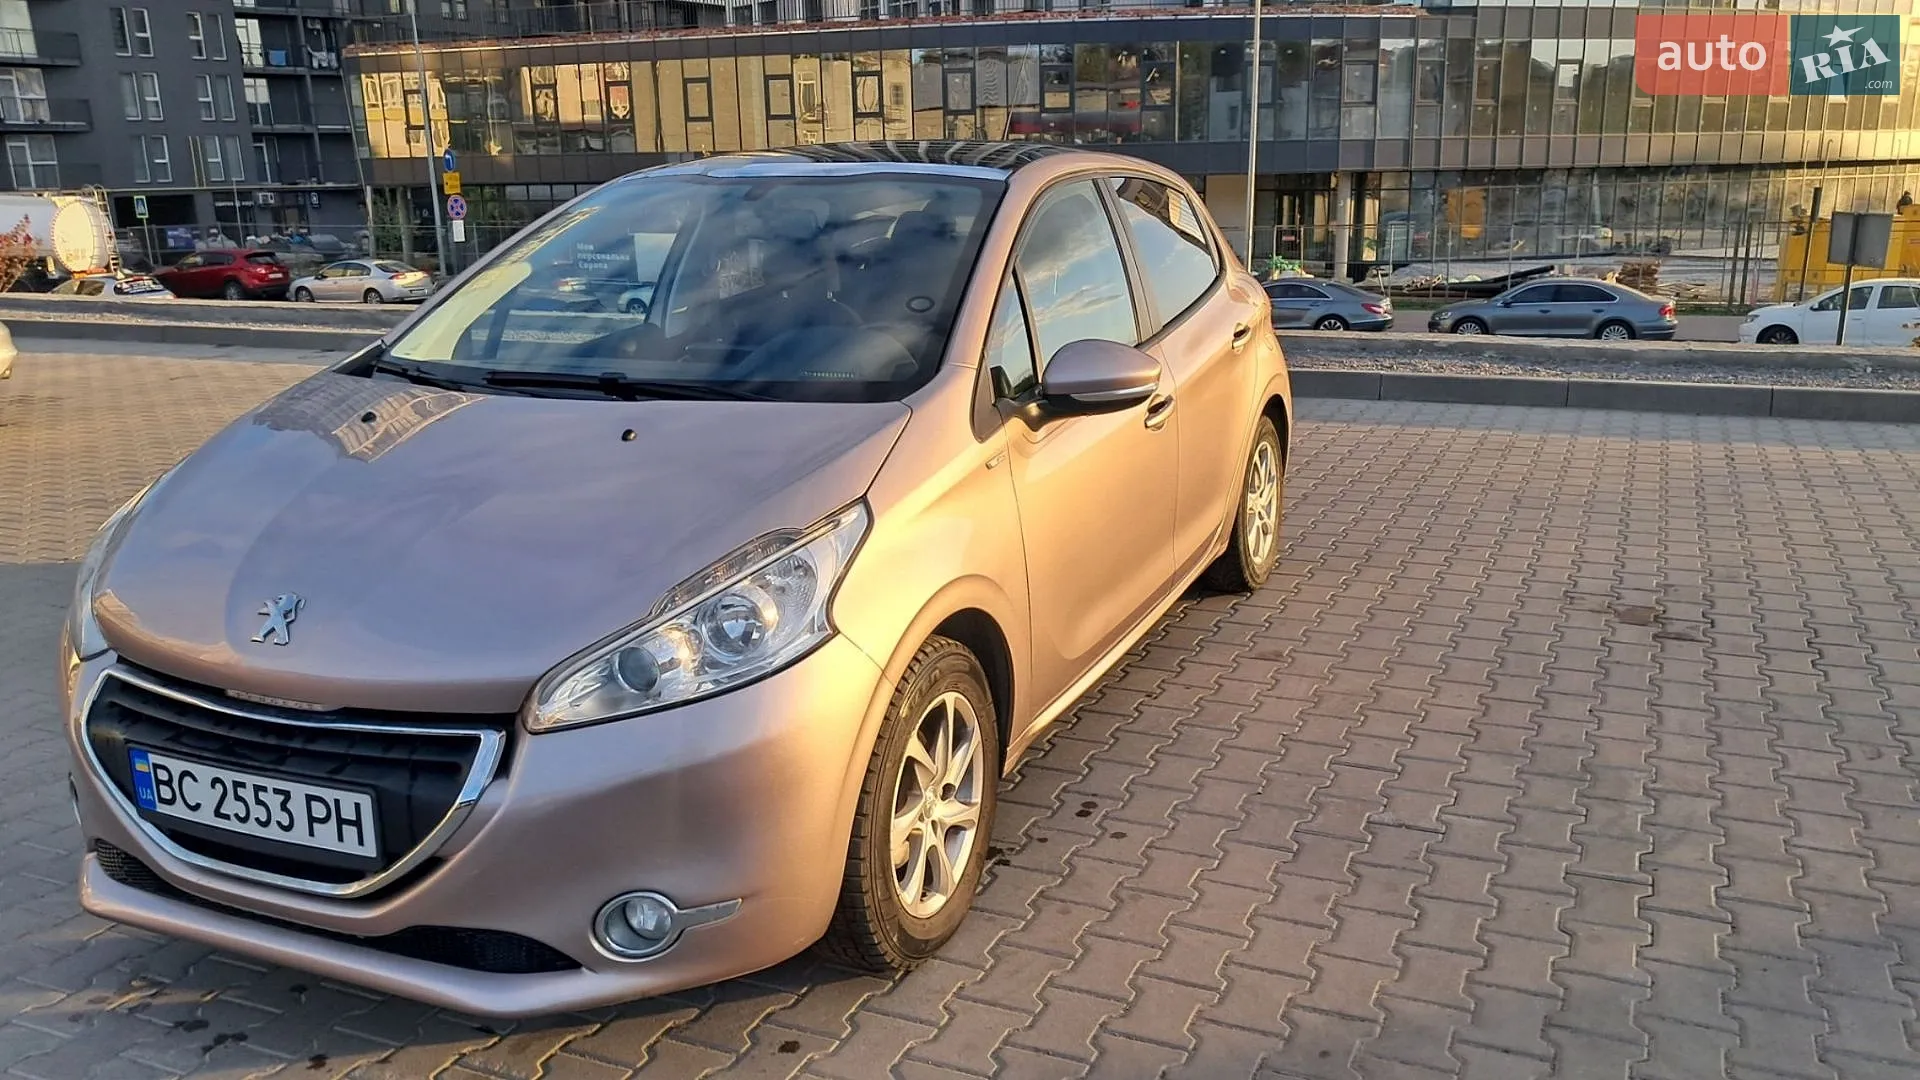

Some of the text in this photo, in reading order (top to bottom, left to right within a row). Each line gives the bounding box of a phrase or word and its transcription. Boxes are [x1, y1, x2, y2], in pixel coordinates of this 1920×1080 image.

[138, 786, 154, 801] UA
[151, 762, 365, 847] BC 2553 PH
